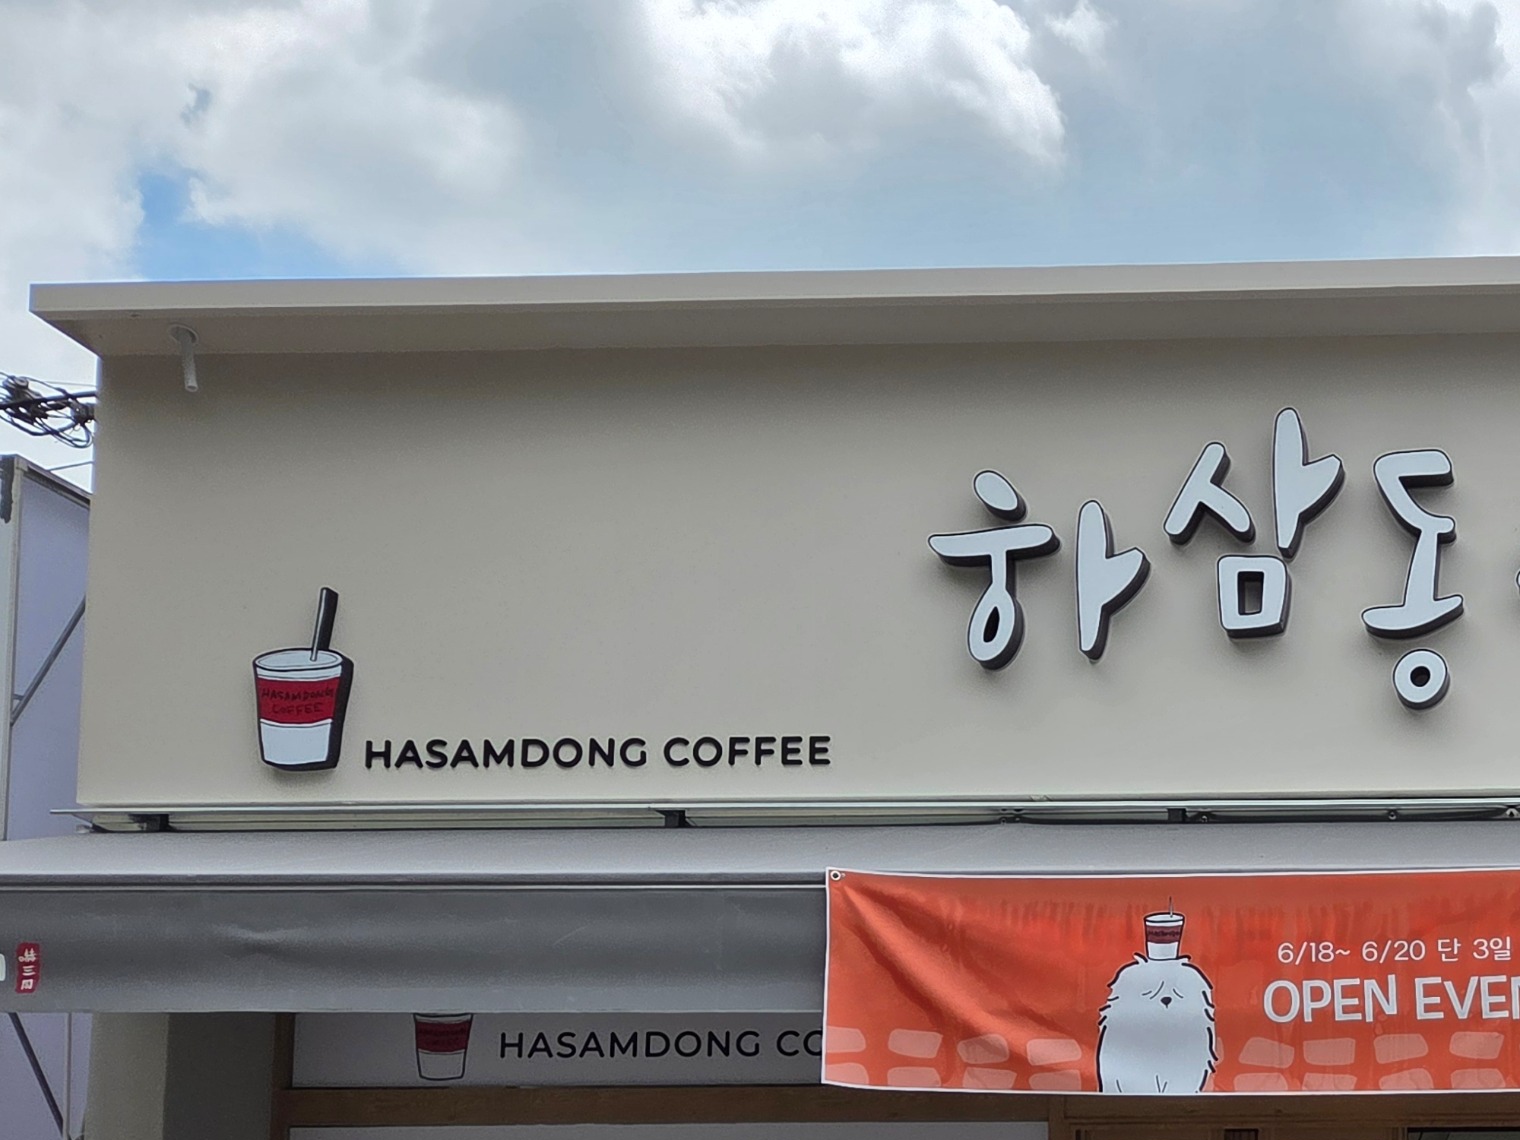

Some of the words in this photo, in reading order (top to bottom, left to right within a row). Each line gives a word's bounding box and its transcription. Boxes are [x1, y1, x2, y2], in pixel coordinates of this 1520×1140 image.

[928, 408, 1465, 712] 하삼동
[365, 736, 648, 770] HASAMDONG
[664, 735, 833, 768] COFFEE
[1277, 941, 1351, 966] 6/18~
[1361, 939, 1426, 964] 6/20
[1437, 938, 1461, 962] 단
[1473, 936, 1512, 961] 3일
[1263, 974, 1399, 1024] OPEN
[499, 1030, 761, 1060] HASAMDONG
